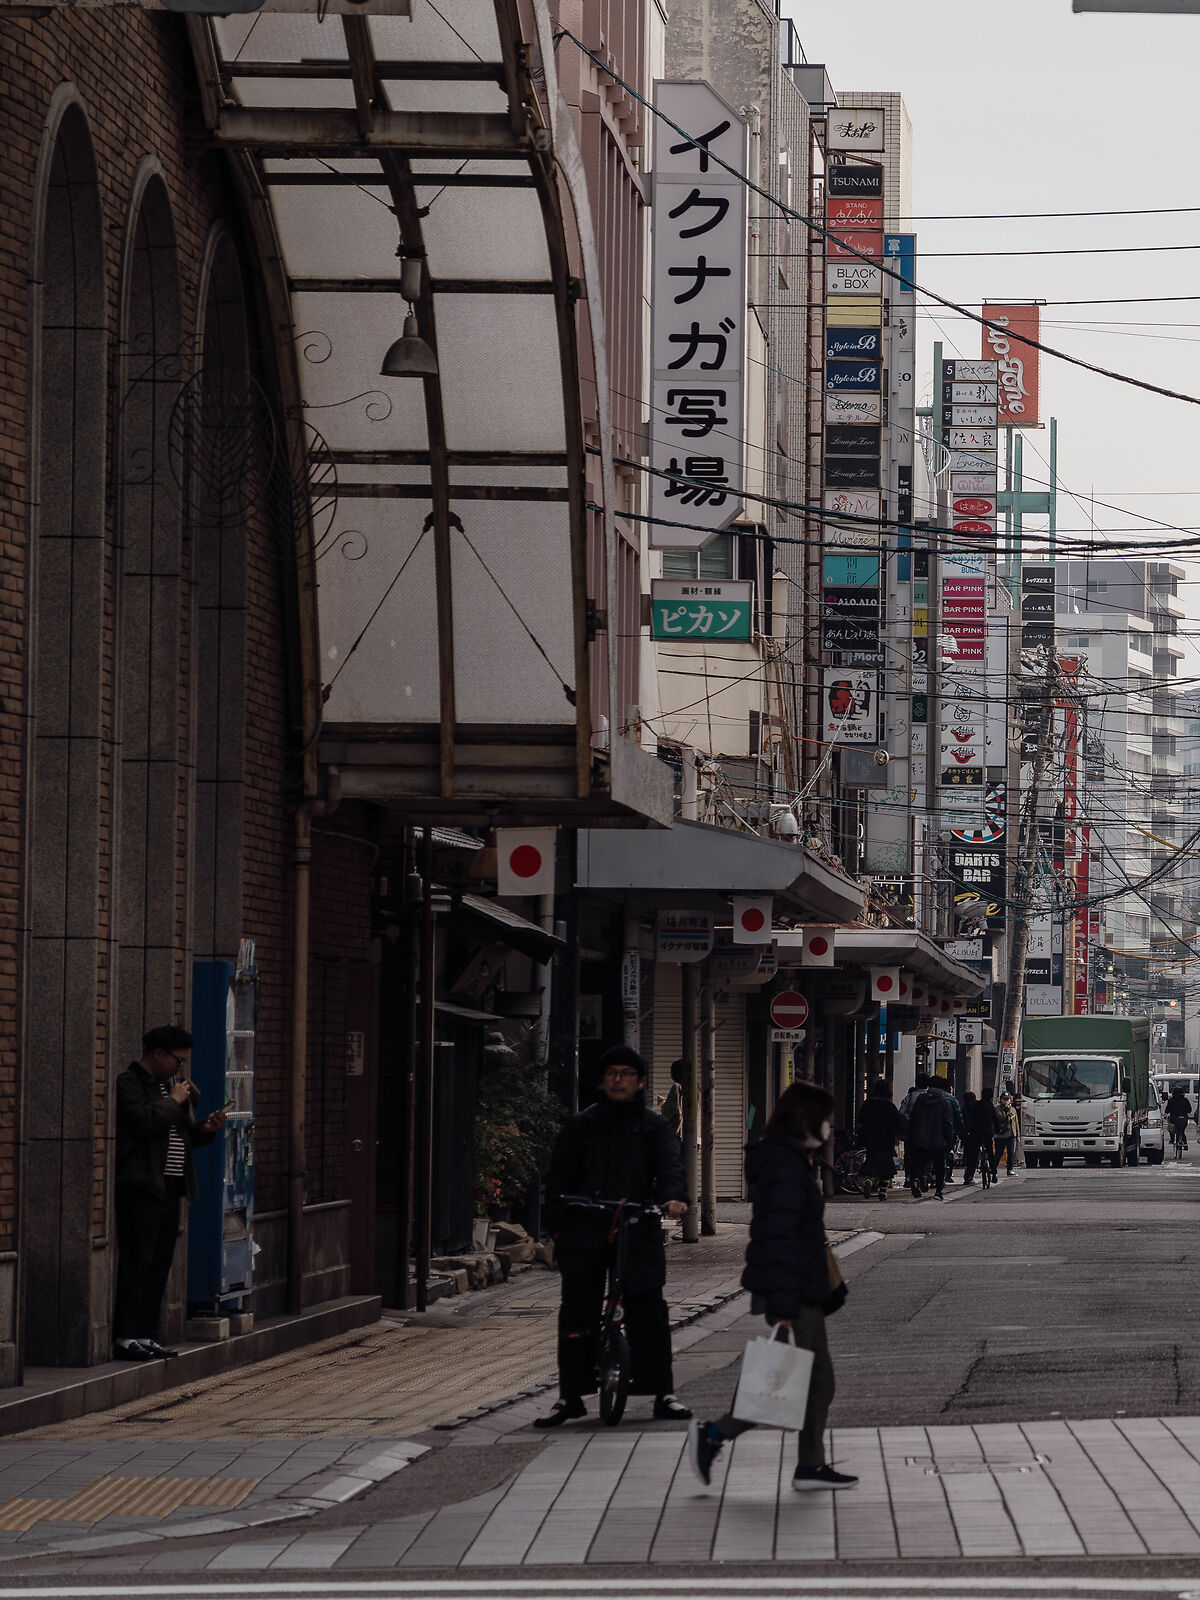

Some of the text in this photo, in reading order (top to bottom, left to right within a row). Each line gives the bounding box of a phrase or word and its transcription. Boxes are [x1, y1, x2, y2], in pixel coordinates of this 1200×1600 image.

[832, 177, 879, 186] TSUNAMI
[837, 269, 876, 278] BLACK
[844, 280, 869, 289] BOX
[664, 120, 736, 506] イクナガ写場
[946, 365, 953, 374] 5
[661, 606, 741, 634] ピカソ
[954, 853, 1000, 867] DARTS
[963, 869, 991, 882] BAR
